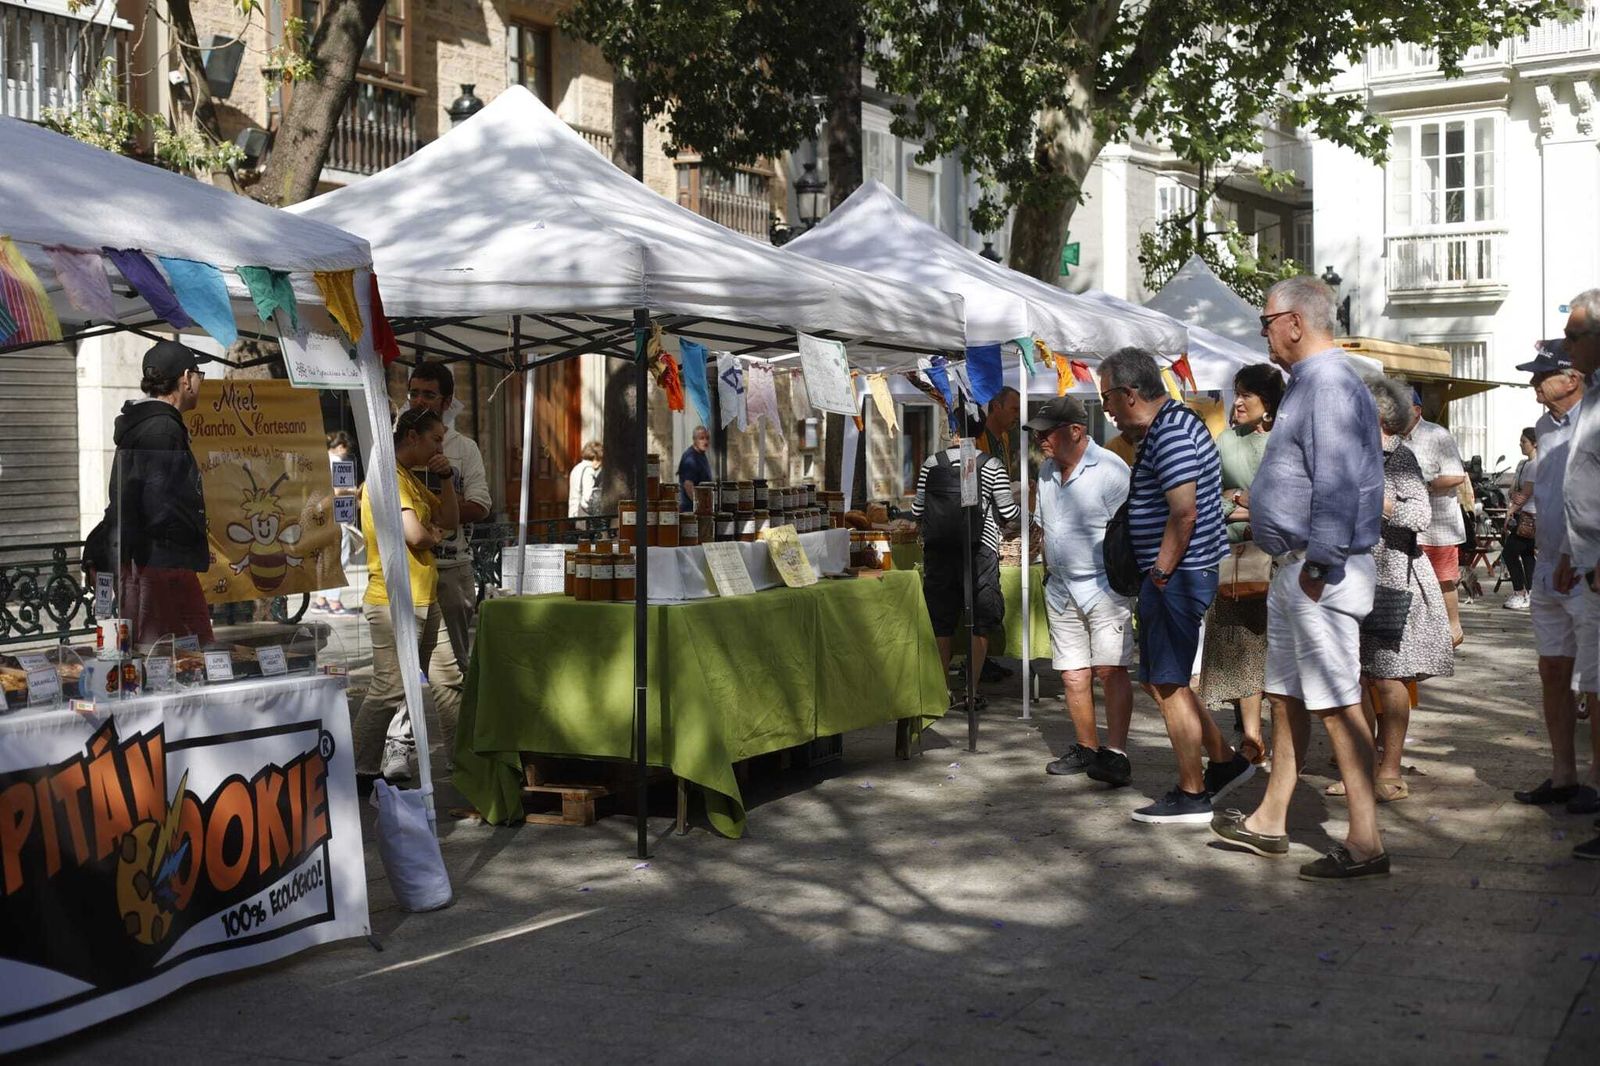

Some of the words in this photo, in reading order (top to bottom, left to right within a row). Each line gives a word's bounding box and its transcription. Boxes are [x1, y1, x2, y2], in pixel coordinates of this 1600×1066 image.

[190, 414, 236, 438] Rancho
[250, 412, 307, 435] Cortesano
[213, 384, 259, 430] Miel
[220, 900, 267, 938] 100%
[269, 860, 324, 917] ECOLÓGICO!
